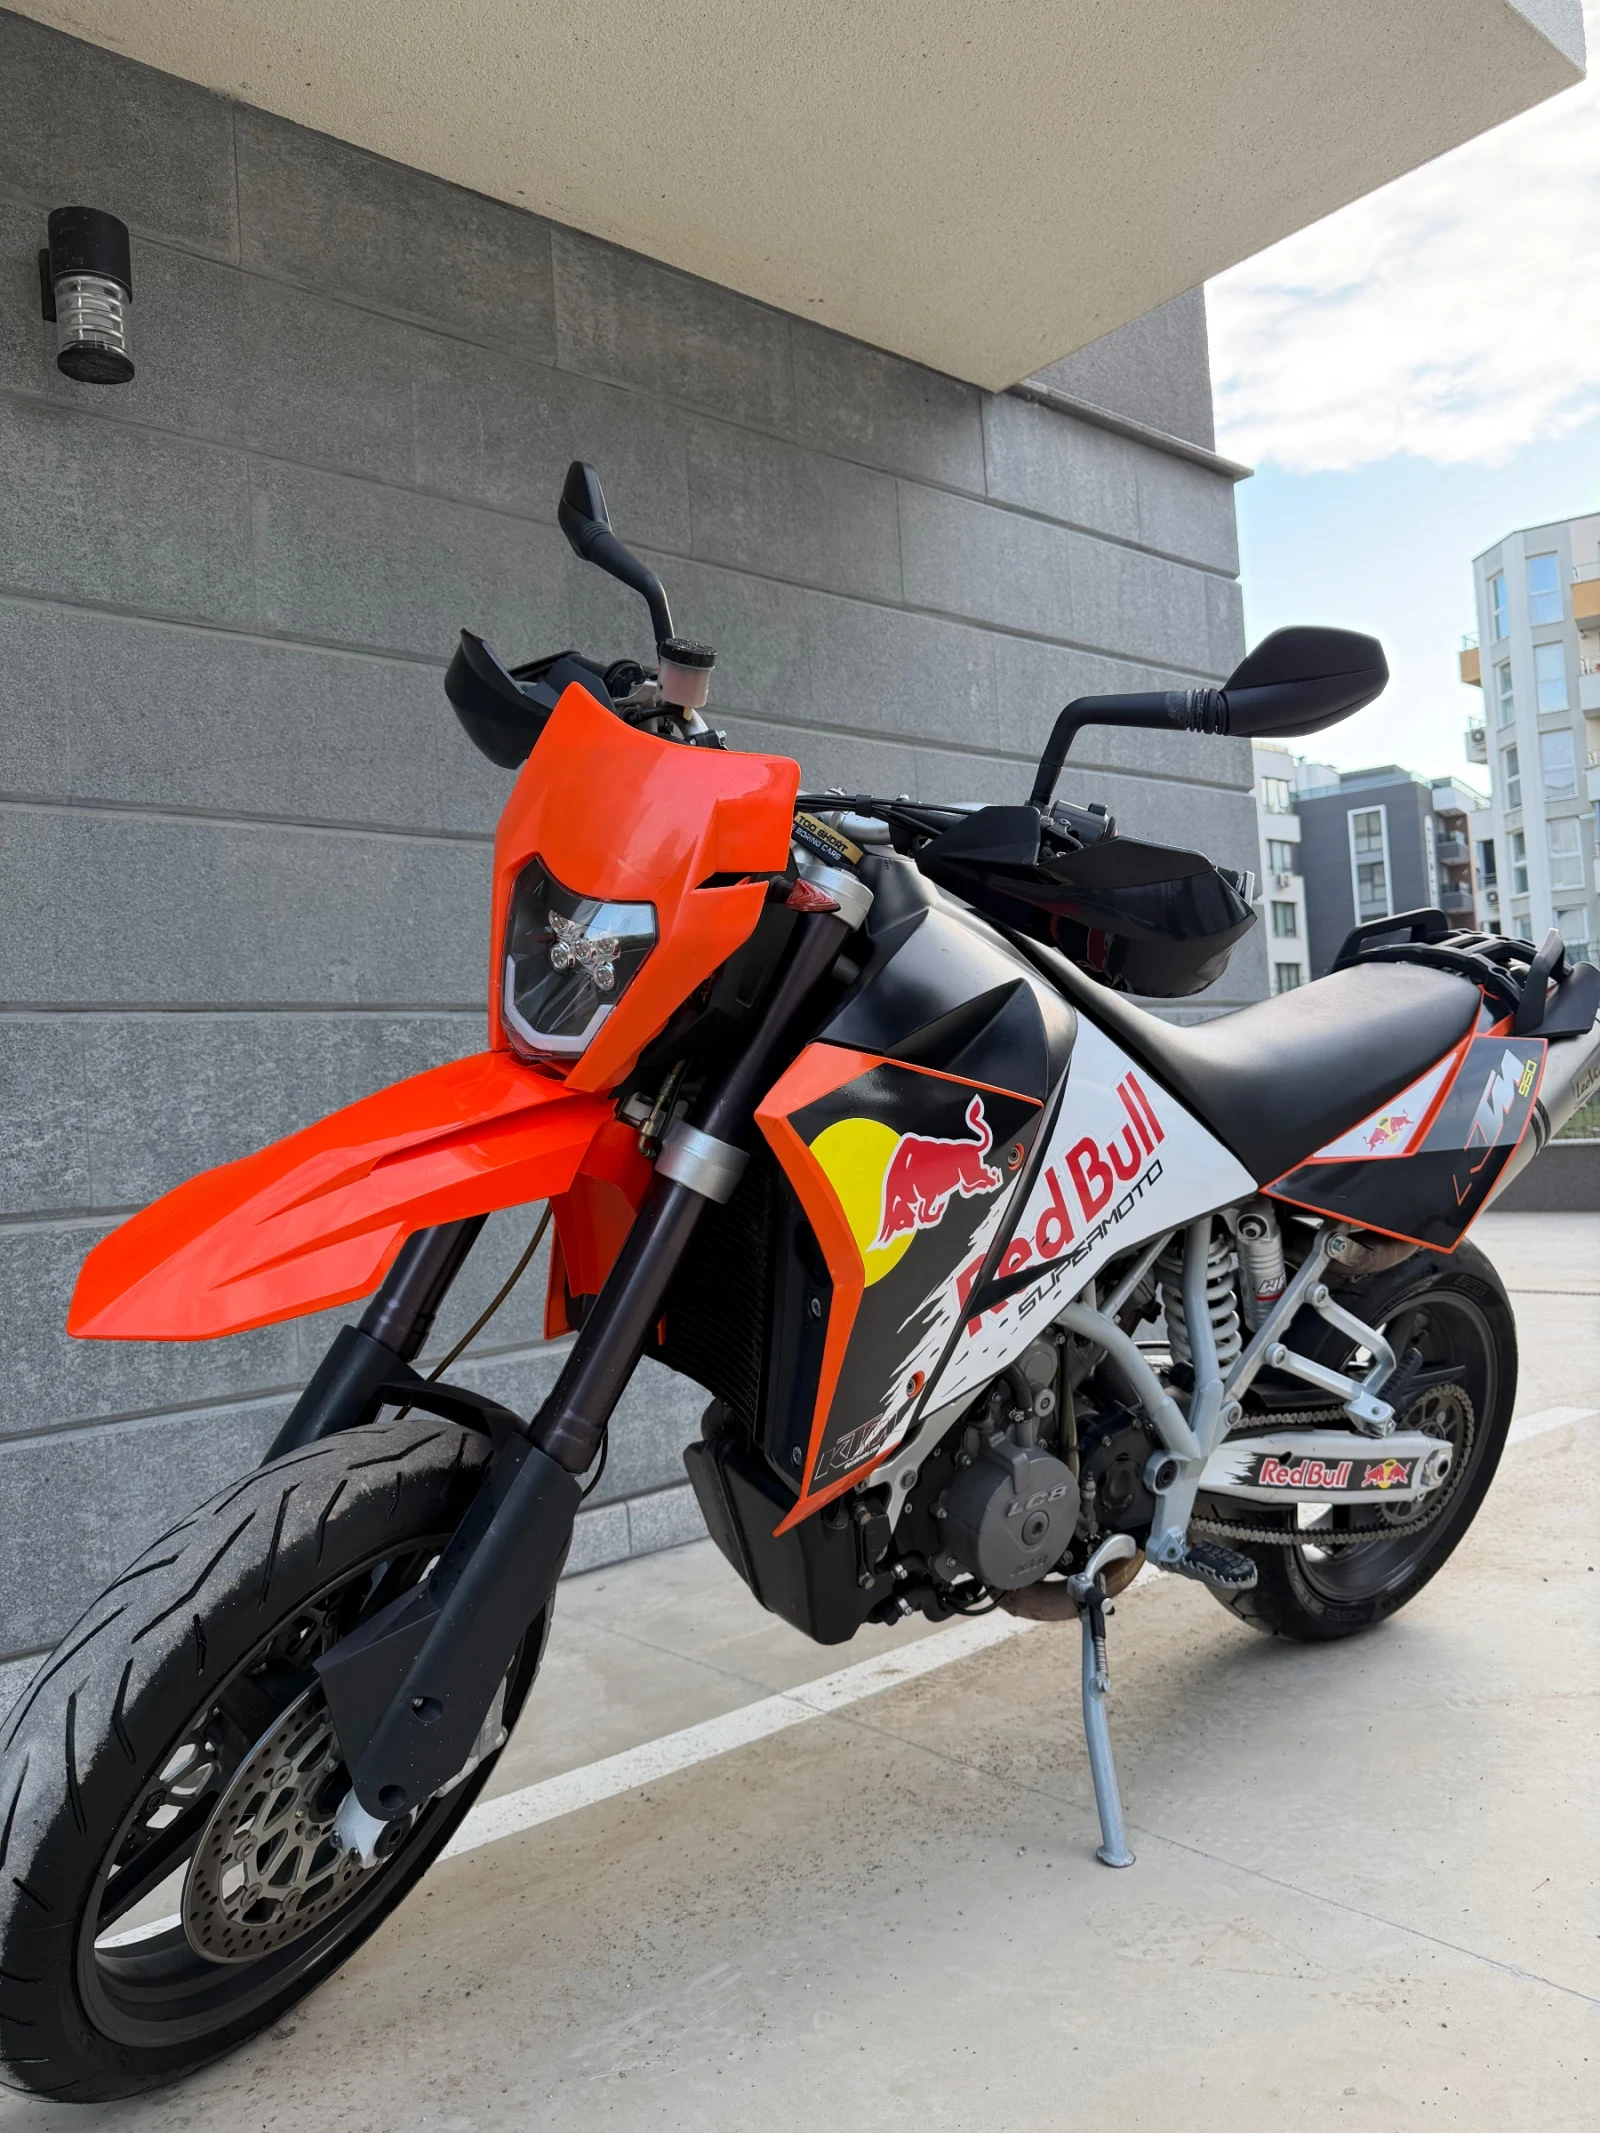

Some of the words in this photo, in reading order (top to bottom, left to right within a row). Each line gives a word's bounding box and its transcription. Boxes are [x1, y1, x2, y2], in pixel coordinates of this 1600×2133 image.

[796, 827, 821, 847] BORING
[822, 845, 842, 860] CARS
[799, 816, 816, 832] TOO
[817, 830, 848, 852] SHORT
[1518, 1059, 1538, 1097] 950
[1065, 1070, 1165, 1223] Bull
[1018, 1159, 1163, 1321] SUPERMOTO
[1260, 1459, 1307, 1485] Red
[1306, 1461, 1352, 1487] Bull
[1006, 1483, 1068, 1517] LC8
